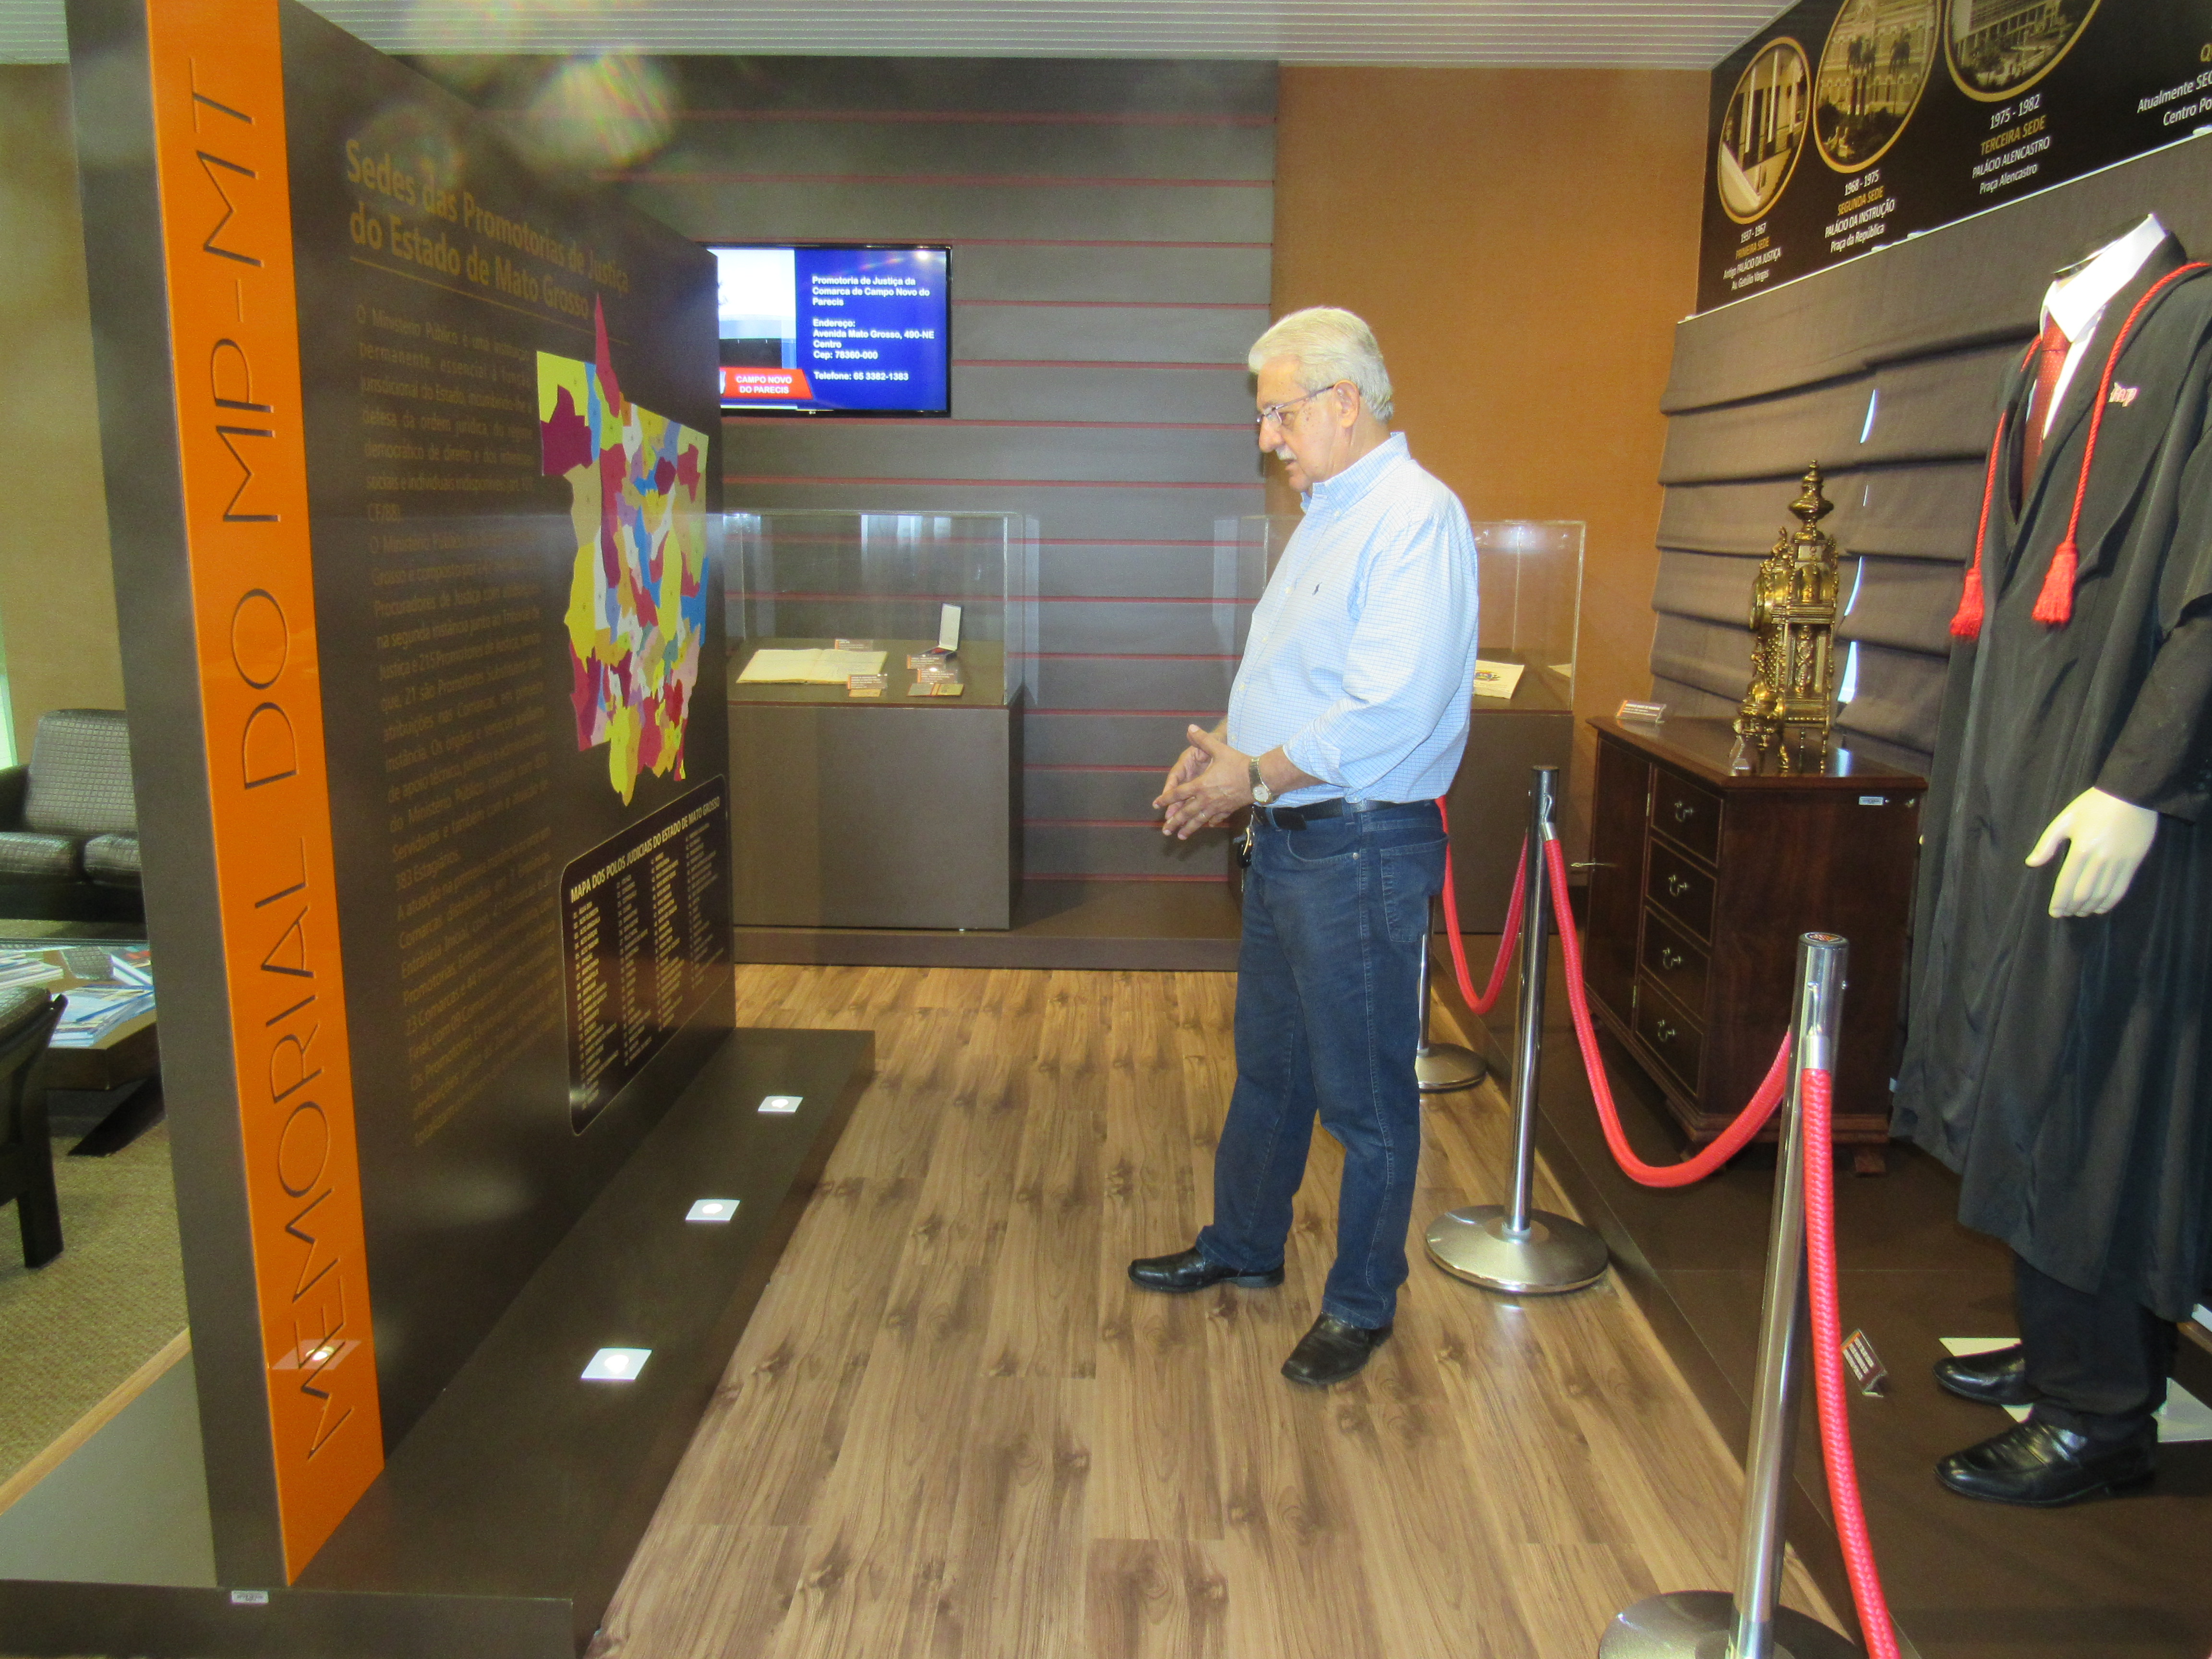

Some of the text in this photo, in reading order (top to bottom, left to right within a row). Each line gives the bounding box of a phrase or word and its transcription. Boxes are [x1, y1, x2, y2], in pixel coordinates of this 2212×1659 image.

[2137, 81, 2194, 114] Atualmente
[1990, 107, 2011, 130] 1975
[2018, 94, 2041, 117] 1982
[2163, 105, 2197, 126] Centro
[1980, 115, 2046, 156] TERCEIRA SEDE
[1972, 135, 2051, 179] PALÁCIO ALENCASTRO
[1844, 179, 1860, 196] 1968
[1863, 169, 1879, 188] 1975
[1979, 164, 2039, 194] Praça Alencastro
[346, 140, 416, 207] Sedes
[421, 183, 458, 223] das
[463, 191, 565, 273] Promotorias
[1838, 185, 1885, 216] SEGUNDA SEDE
[1825, 198, 1896, 239] PALÁCIO DA INSTRUÇÃO
[350, 201, 384, 250] do
[390, 213, 461, 276] Estado
[466, 244, 491, 286] de
[494, 255, 539, 302] Mato
[1830, 223, 1885, 253] Praça da República
[1762, 246, 1781, 264] JUSTIÇA
[812, 276, 916, 288] Promotoria de Justiça da
[812, 288, 930, 298] Comarca de Campo Novo do
[812, 298, 844, 306] Parecis
[813, 318, 855, 329] Endereço:
[813, 329, 935, 340] Avenida Mato Grosso, 490-NE
[813, 340, 842, 349] Centro
[814, 351, 878, 360] Cep: 78360-000
[736, 375, 793, 384] CAMPO NOVO
[740, 385, 789, 394] DO PARECIS
[814, 371, 909, 381] Telefone: 65 3382-1383
[189, 56, 355, 1463] MEMORIAL DO MP-MT
[571, 874, 591, 903] MAPA
[591, 867, 606, 888] DOS
[606, 855, 626, 879] POLOS
[626, 837, 652, 866] JUDICIAIS
[652, 832, 662, 848] DO
[661, 819, 682, 843] ESTADO
